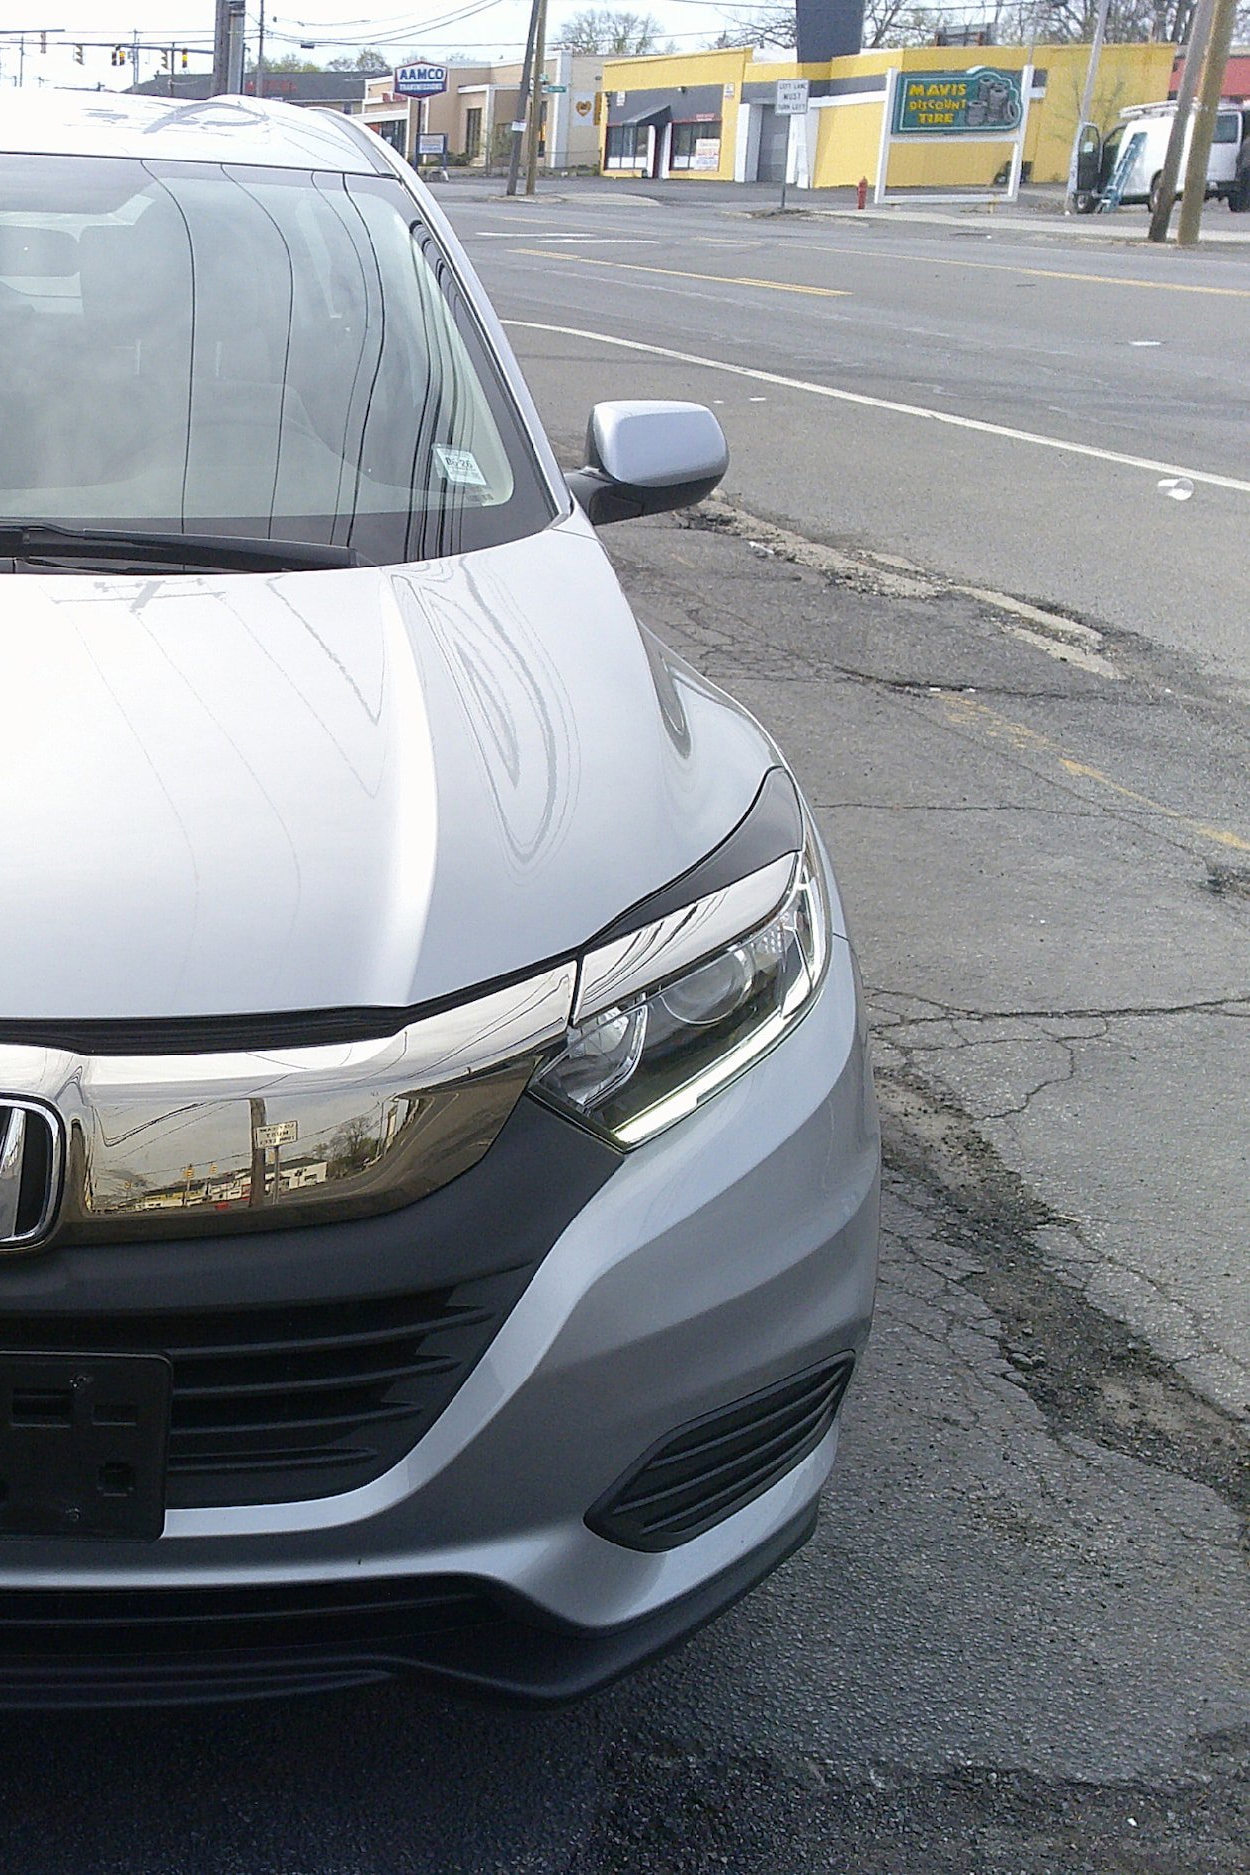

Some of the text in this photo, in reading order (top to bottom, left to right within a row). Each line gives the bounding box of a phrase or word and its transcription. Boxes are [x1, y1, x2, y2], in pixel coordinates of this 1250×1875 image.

[400, 68, 444, 79] AAMCO
[910, 84, 967, 96] MAVIS
[783, 92, 800, 101] MUST
[909, 99, 967, 111] DISCOUNT
[918, 114, 954, 124] TIRE
